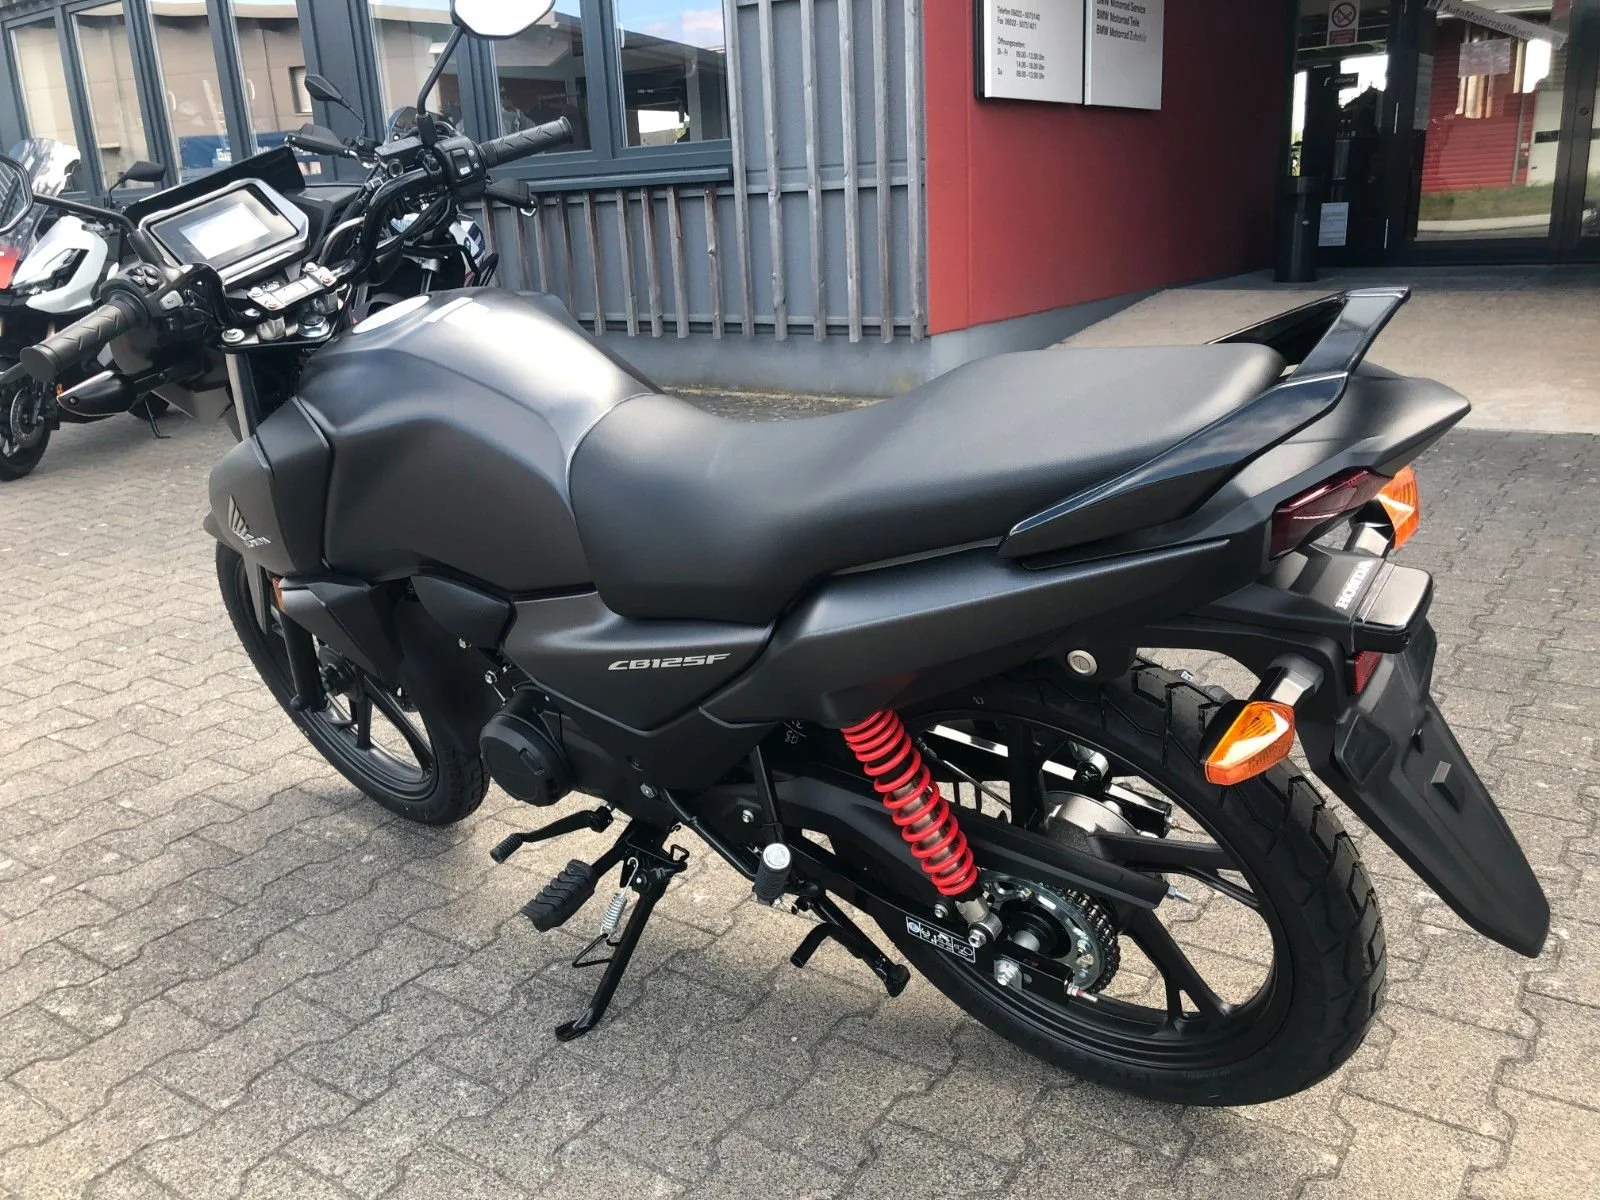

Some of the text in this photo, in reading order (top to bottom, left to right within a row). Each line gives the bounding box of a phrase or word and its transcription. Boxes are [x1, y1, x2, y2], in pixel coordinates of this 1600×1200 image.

[1096, 9, 1109, 20] BMW
[1096, 24, 1109, 35] BMW
[1335, 560, 1375, 610] HONDA
[608, 653, 731, 670] CB125F
